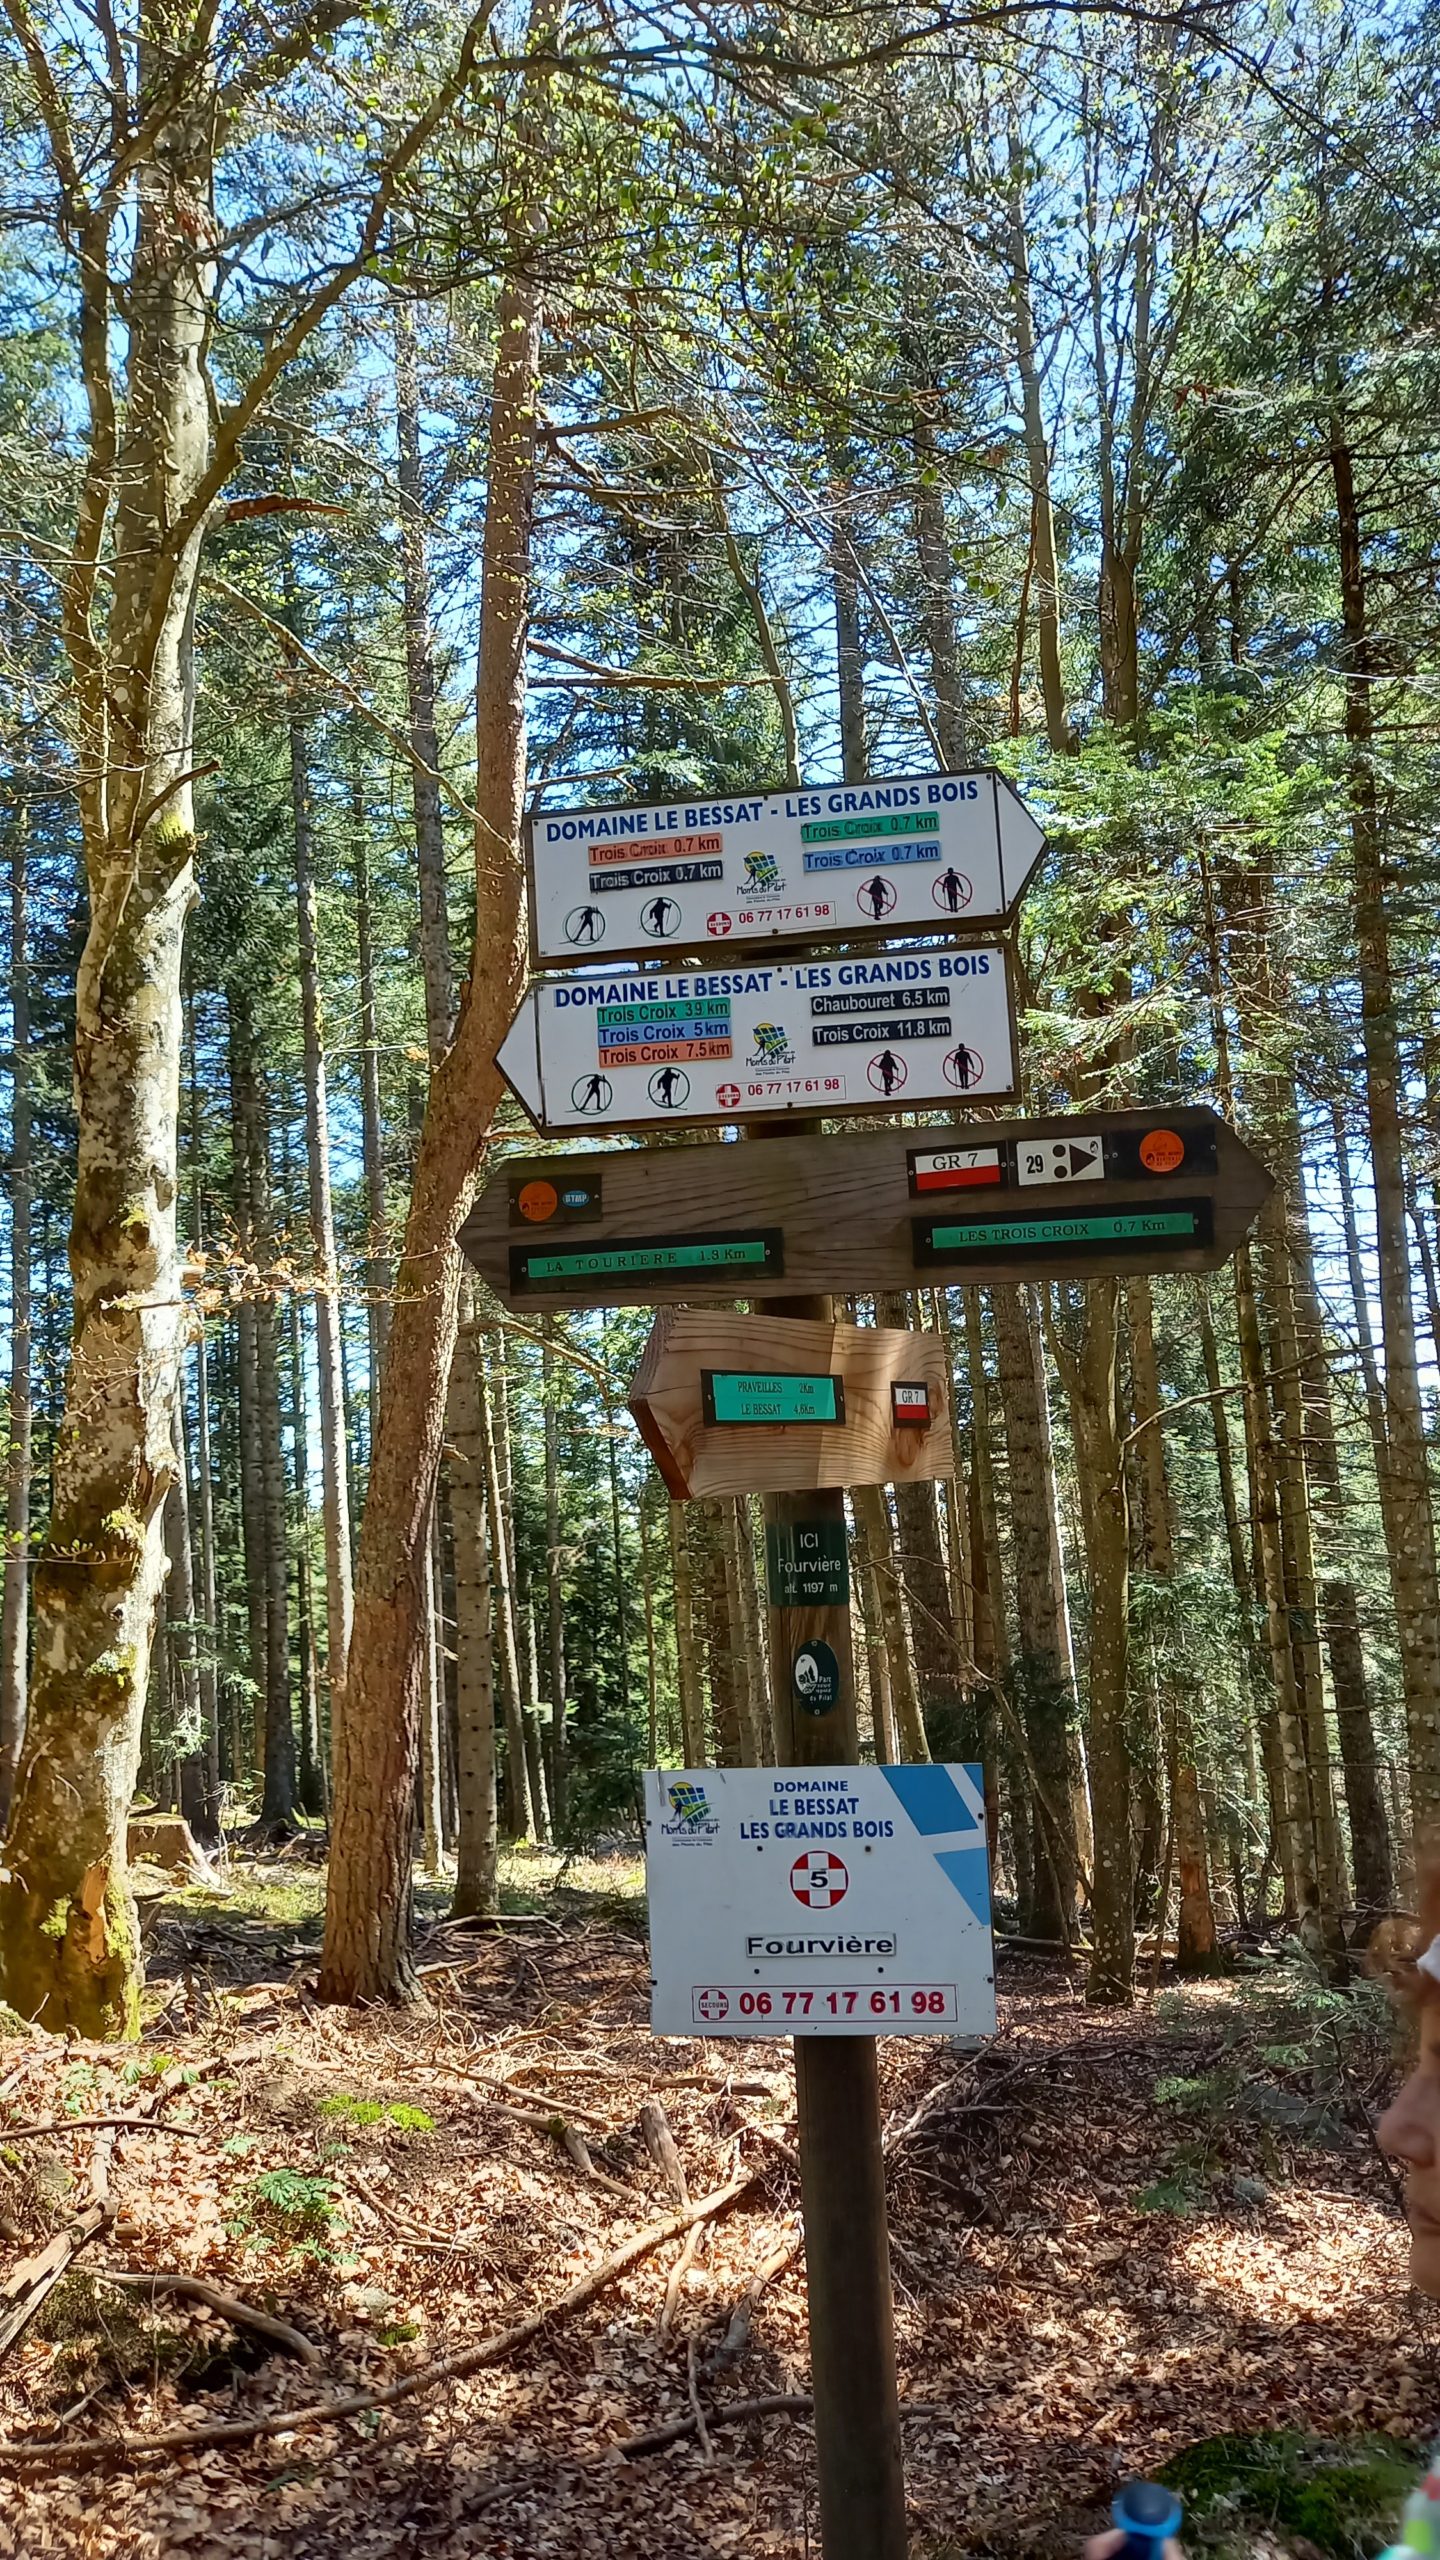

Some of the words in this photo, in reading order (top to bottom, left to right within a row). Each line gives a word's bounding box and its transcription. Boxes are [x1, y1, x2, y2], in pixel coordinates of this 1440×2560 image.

[546, 813, 648, 842] DOMAINE
[654, 811, 678, 831] LE
[685, 802, 763, 828] BESSAT
[786, 796, 821, 817] LES
[828, 786, 920, 812] GRANDS
[927, 780, 978, 804] BOIS
[803, 823, 840, 839] Trois
[844, 820, 883, 835] Croix
[890, 816, 910, 831] 0.7
[916, 814, 937, 829] km
[589, 845, 625, 862] Trois
[629, 841, 666, 857] Croix
[674, 837, 694, 853] 0.7
[698, 835, 720, 851] km
[804, 852, 843, 869] Trois
[845, 849, 885, 865] Croix
[892, 846, 912, 861] 0.7
[917, 844, 938, 859] km
[591, 872, 630, 891] Trois
[632, 869, 671, 885] Croix
[676, 866, 695, 881] 0.7
[700, 863, 721, 878] km
[739, 912, 754, 924] 06
[758, 910, 772, 922] 77
[777, 908, 791, 920] 17
[795, 906, 809, 919] 61
[815, 904, 829, 916] 98
[555, 982, 659, 1008] DOMAINE
[666, 979, 689, 998] LE
[694, 972, 773, 997] BESSAT
[795, 967, 831, 989] LES
[838, 959, 932, 985] GRANDS
[939, 955, 989, 978] BOIS
[813, 993, 895, 1012] Chaubouret
[927, 990, 948, 1004] km
[599, 1006, 635, 1023] Trois
[639, 1005, 677, 1020] Croix
[707, 1001, 728, 1015] km
[599, 1027, 639, 1044] Trois
[643, 1024, 685, 1041] Croix
[694, 1022, 703, 1037] 5
[706, 1022, 728, 1035] km
[814, 1027, 849, 1043] Trois
[852, 1025, 890, 1040] Croix
[929, 1020, 949, 1035] km
[601, 1048, 637, 1064] Trois
[641, 1046, 679, 1061] Croix
[686, 1043, 707, 1058] 7.5
[709, 1041, 730, 1056] km
[748, 1084, 763, 1096] 06
[767, 1083, 781, 1094] 77
[787, 1081, 801, 1093] 17
[805, 1080, 818, 1091] 61
[824, 1078, 839, 1090] 98
[932, 1155, 962, 1170] GR
[967, 1153, 978, 1167] 7
[1026, 1154, 1044, 1175] 29
[959, 1230, 987, 1243] LES
[991, 1226, 1037, 1241] TROIS
[1041, 1223, 1089, 1237] CROIX
[1113, 1220, 1136, 1233] 0.7
[1141, 1219, 1165, 1231] Km
[546, 1260, 564, 1273] LA
[576, 1252, 677, 1270] TOURIERE
[724, 1249, 746, 1260] Km
[737, 1382, 783, 1394] PRAVEILLES
[901, 1390, 914, 1403] GR
[914, 1390, 920, 1403] 7
[741, 1404, 751, 1415] LE
[753, 1403, 781, 1415] BESSAT
[800, 1533, 819, 1549] ICI
[778, 1555, 841, 1574] Fourvière
[803, 1582, 824, 1593] 1197
[829, 1584, 838, 1592] m
[773, 1781, 848, 1792] DOMAINE
[769, 1799, 789, 1815] LE
[794, 1798, 859, 1816] BESSAT
[740, 1822, 769, 1839] LES
[774, 1821, 850, 1838] GRANDS
[853, 1820, 894, 1837] BOIS
[810, 1870, 829, 1888] 5
[748, 1936, 893, 1955] Fourvière
[739, 1992, 772, 2014] 06
[782, 1992, 814, 2014] 77
[826, 1992, 859, 2014] 17
[870, 1991, 900, 2014] 61
[911, 1991, 945, 2014] 98
